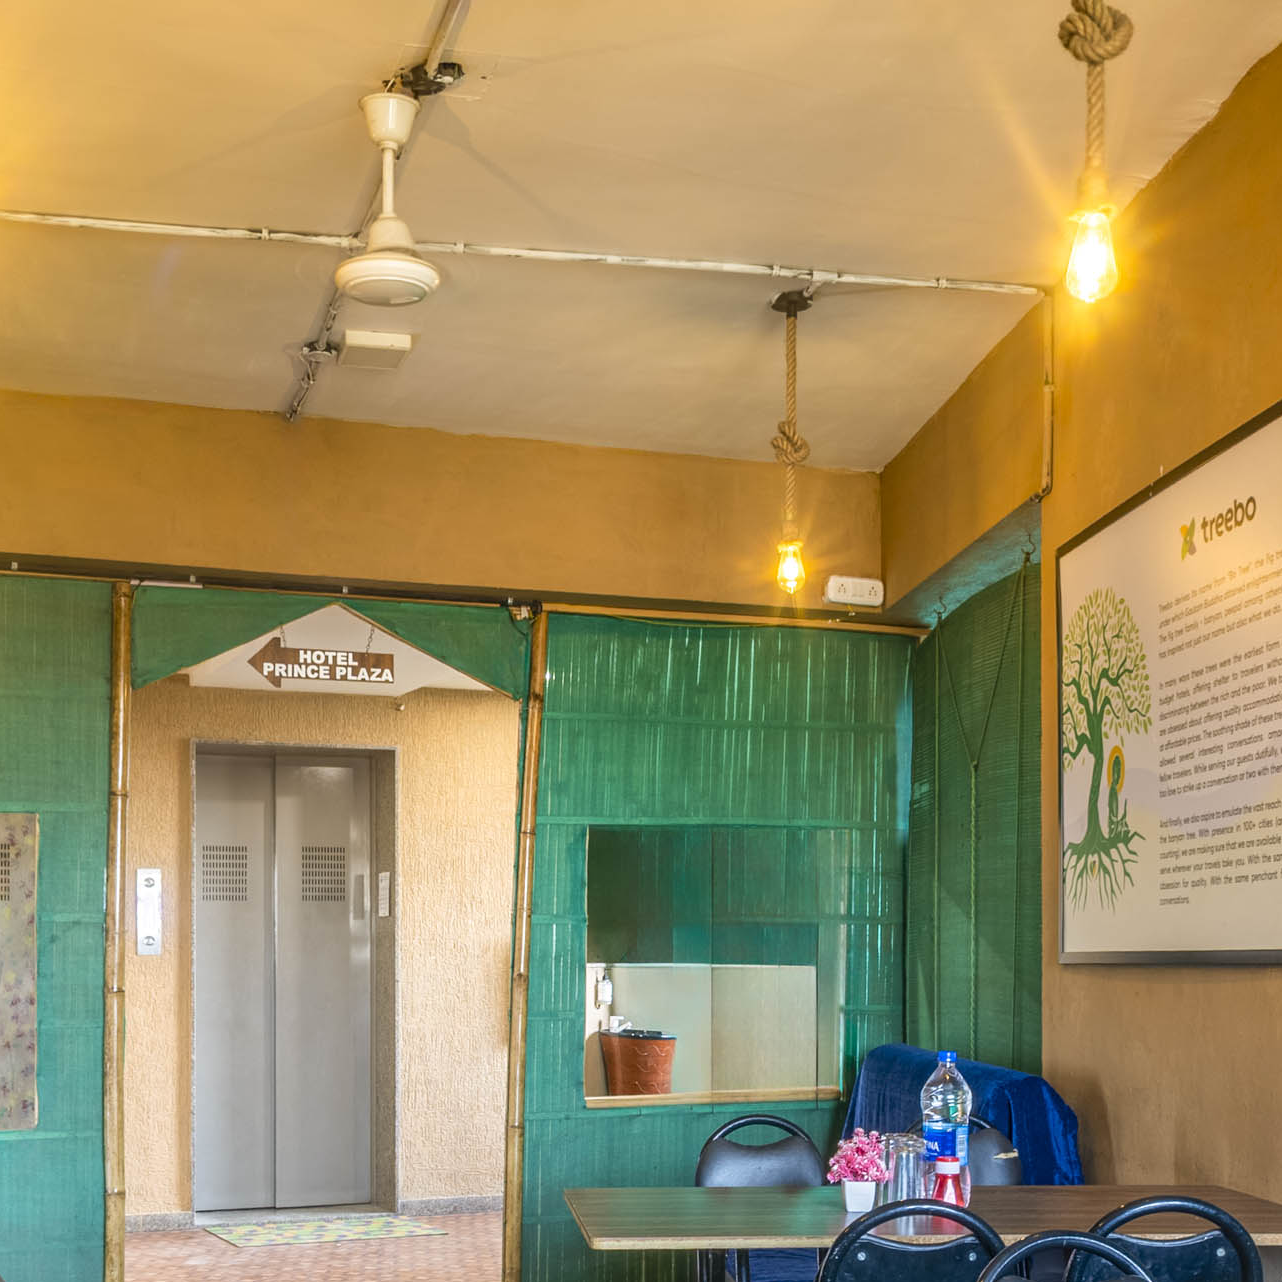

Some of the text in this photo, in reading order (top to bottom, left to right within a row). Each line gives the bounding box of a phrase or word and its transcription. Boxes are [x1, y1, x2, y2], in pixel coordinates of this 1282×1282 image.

[1201, 496, 1256, 543] treebo
[1204, 593, 1222, 608] Buddha
[1244, 594, 1262, 608] among
[1265, 586, 1282, 600] others
[1226, 620, 1235, 633] but
[1236, 618, 1247, 629] also
[1248, 610, 1261, 624] what
[1263, 608, 1271, 618] we
[299, 649, 358, 666] HOTEL
[1204, 663, 1217, 674] trees
[1219, 658, 1230, 669] were
[1232, 653, 1242, 664] the
[1244, 644, 1263, 660] earliest
[1265, 641, 1279, 653] form
[262, 662, 393, 682] PRINCE PLAZA
[1212, 675, 1229, 688] shelter
[1232, 672, 1237, 681] to
[1239, 664, 1263, 679] travelers
[1210, 695, 1218, 705] the
[1220, 690, 1229, 702] rich
[1230, 687, 1240, 699] and
[1241, 685, 1250, 695] the
[1252, 682, 1265, 695] poor.
[1267, 677, 1276, 687] We
[1203, 711, 1222, 723] offering
[1223, 705, 1240, 720] quality
[1212, 725, 1233, 737] soothing
[1234, 719, 1250, 731] shade
[1251, 716, 1257, 727] of
[1258, 714, 1272, 725] these
[1197, 744, 1223, 757] interesting
[1227, 735, 1262, 750] conversations
[1208, 760, 1225, 771] serving
[1226, 758, 1235, 767] our
[1236, 753, 1253, 767] guests
[1255, 747, 1277, 761] dutifully,
[1206, 774, 1237, 788] conversation
[1239, 773, 1244, 781] or
[1245, 770, 1256, 780] two
[1257, 766, 1269, 777] with
[1200, 811, 1214, 823] aspire
[1215, 810, 1220, 819] to
[1221, 806, 1242, 818] emulate
[1243, 804, 1251, 814] the
[1253, 802, 1264, 813] vast
[1265, 799, 1281, 811] reach
[1211, 826, 1233, 839] presence
[1235, 823, 1240, 832] in
[1243, 820, 1255, 831] 100+
[1258, 819, 1272, 829] cities
[1215, 844, 1224, 852] sure
[1225, 840, 1236, 851] that
[1237, 841, 1244, 849] we
[1246, 840, 1254, 848] are
[1256, 834, 1281, 847] available
[1204, 859, 1221, 870] travels
[1222, 858, 1233, 868] take
[1247, 854, 1260, 865] With
[1261, 853, 1271, 863] the
[1210, 876, 1221, 885] With
[1223, 875, 1232, 884] the
[1234, 875, 1249, 883] same
[1251, 870, 1277, 884] penchant
